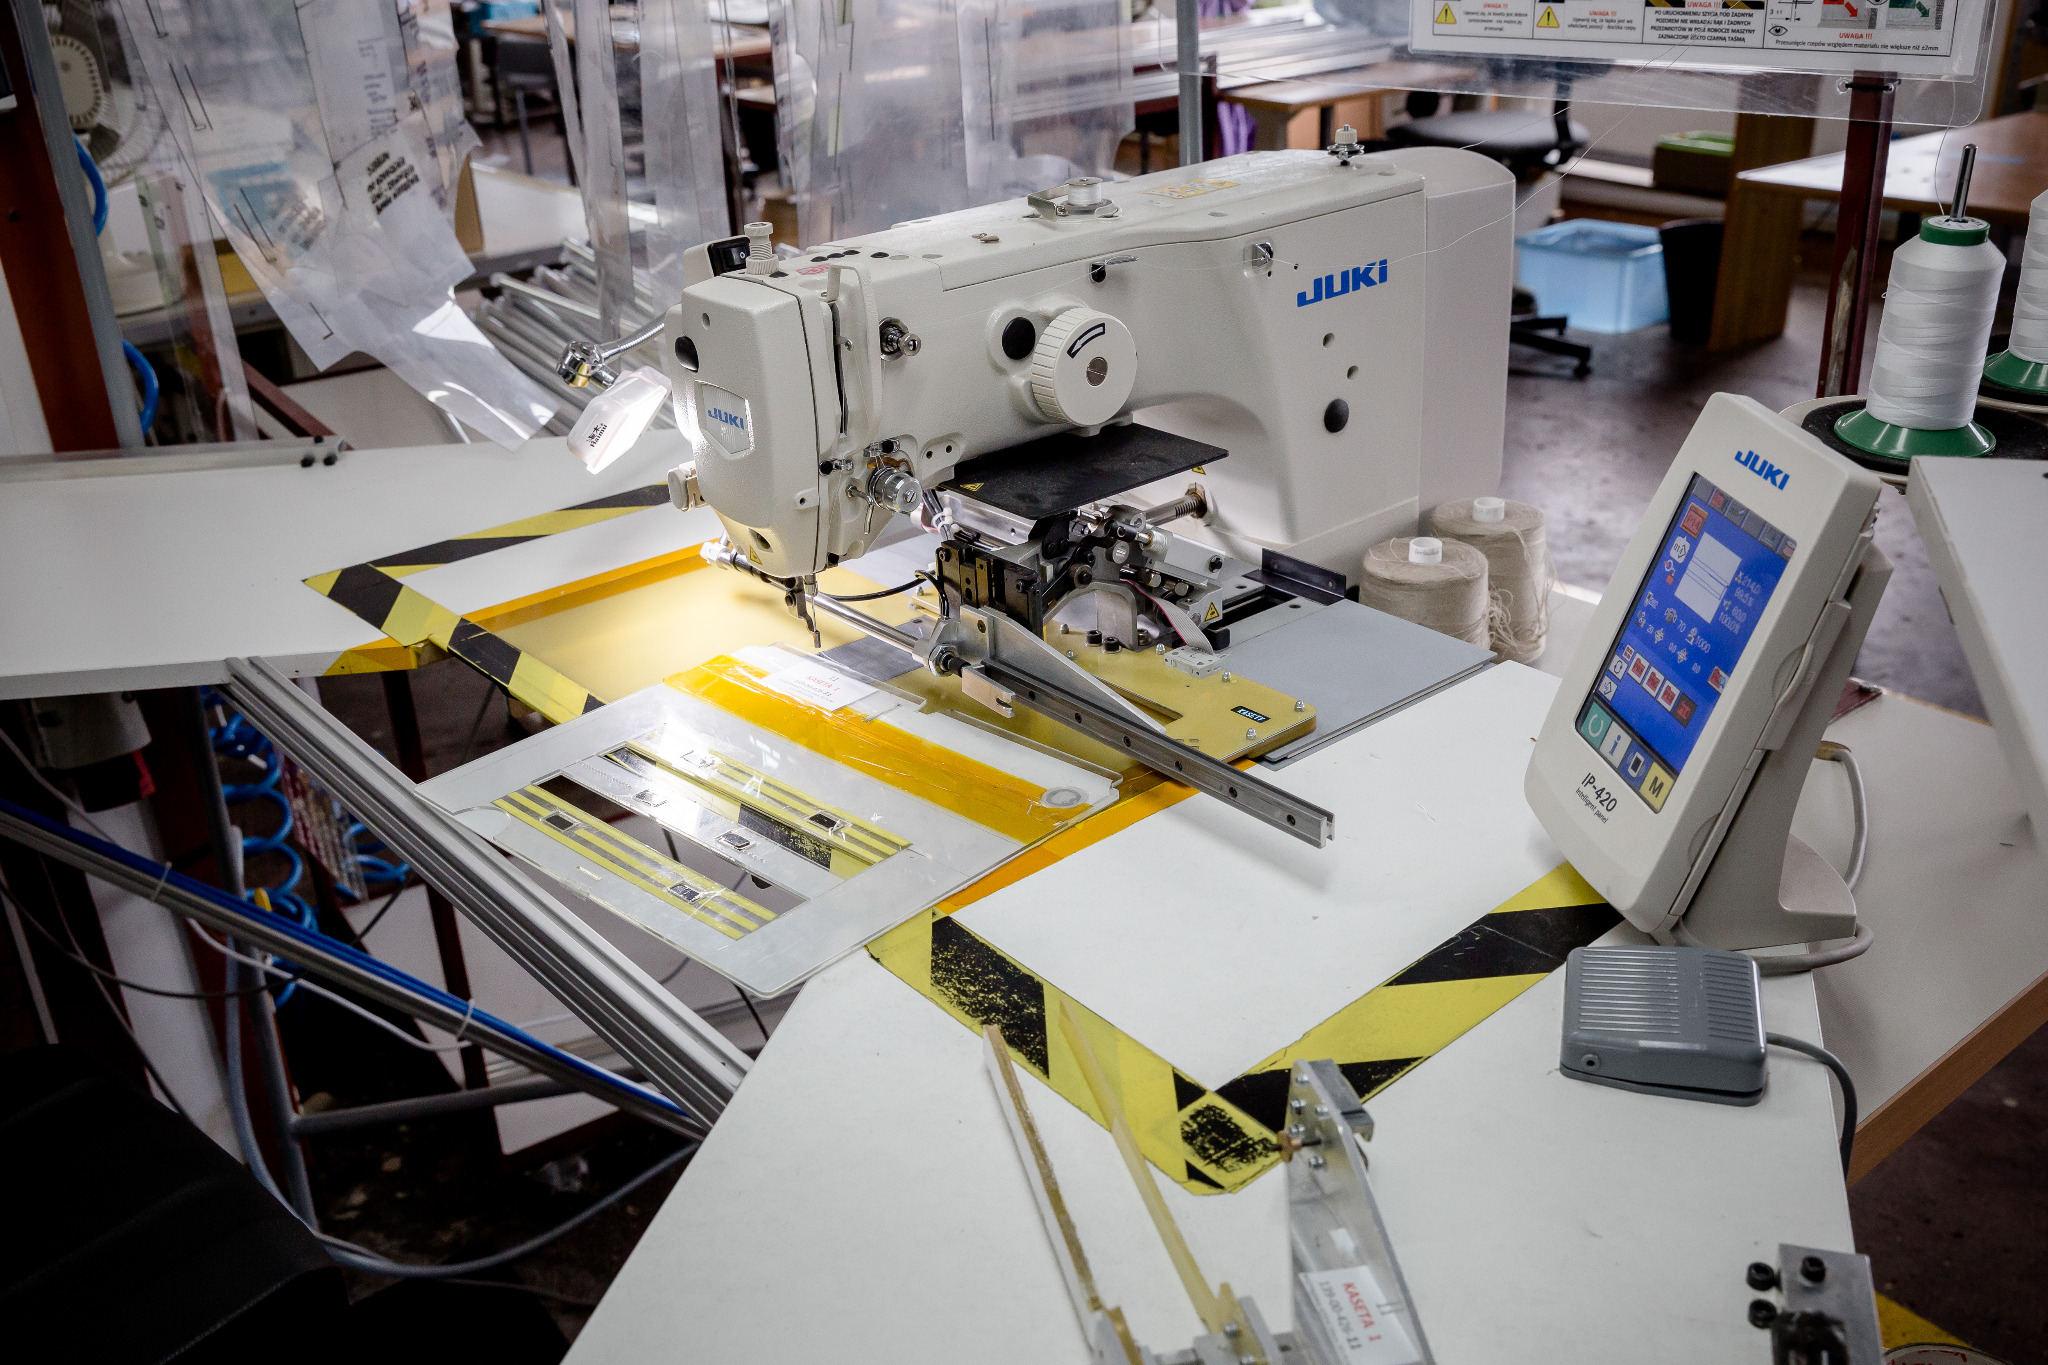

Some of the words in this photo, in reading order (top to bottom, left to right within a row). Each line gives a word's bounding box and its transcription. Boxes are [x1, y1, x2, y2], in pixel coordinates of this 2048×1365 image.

[1297, 258, 1388, 308] JUKI
[708, 408, 744, 430] JUKI
[590, 424, 608, 448] Haimu
[1734, 449, 1790, 492] JUKI
[1694, 635, 1711, 654] 1000
[807, 676, 833, 688] KASETA
[1236, 708, 1266, 722] KASETY
[1581, 772, 1618, 813] IP-420
[1650, 776, 1665, 798] M
[1576, 786, 1597, 812] Intelligent
[1594, 808, 1609, 824] panel
[1342, 1282, 1376, 1329] KASETA
[1368, 1334, 1382, 1342] 1
